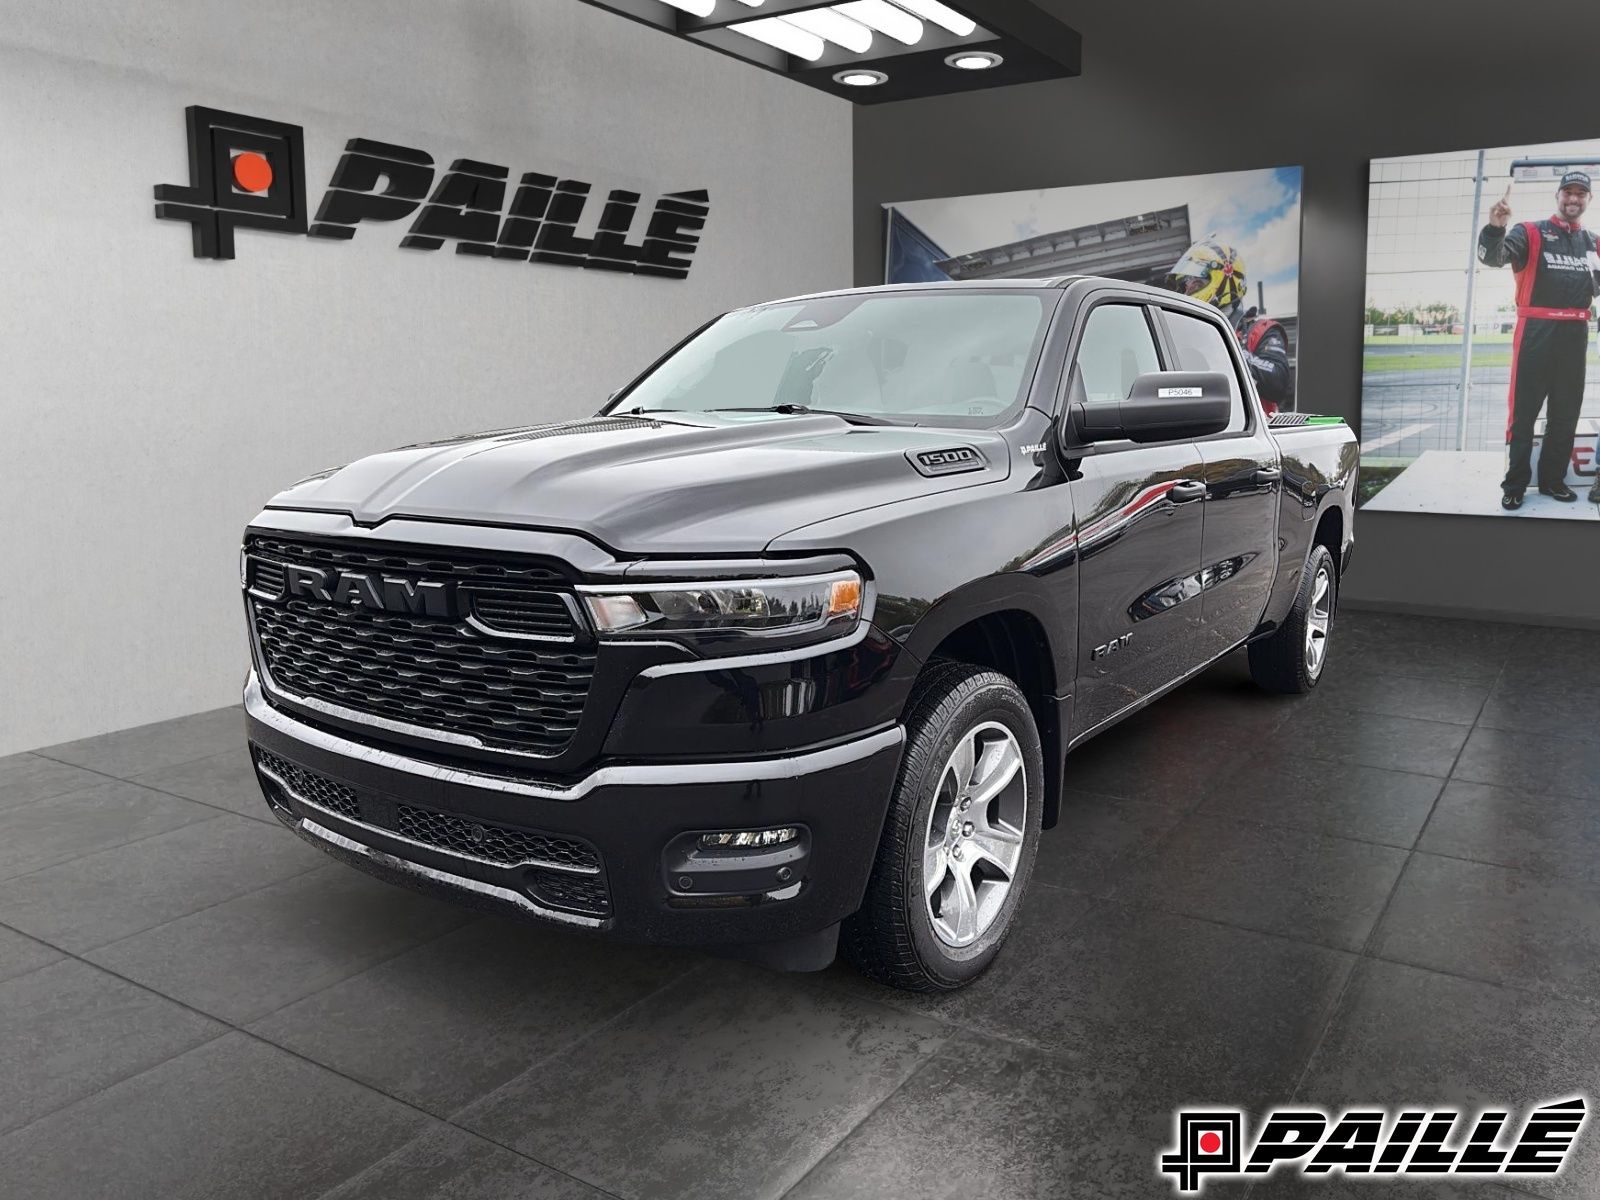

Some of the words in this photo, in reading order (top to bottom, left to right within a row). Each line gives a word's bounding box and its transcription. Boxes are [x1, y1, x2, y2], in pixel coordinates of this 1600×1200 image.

[307, 137, 709, 280] PAILLÉ
[1168, 388, 1193, 397] P5046
[920, 450, 972, 465] 1500
[287, 563, 447, 617] RAM
[1091, 632, 1133, 660] RAM
